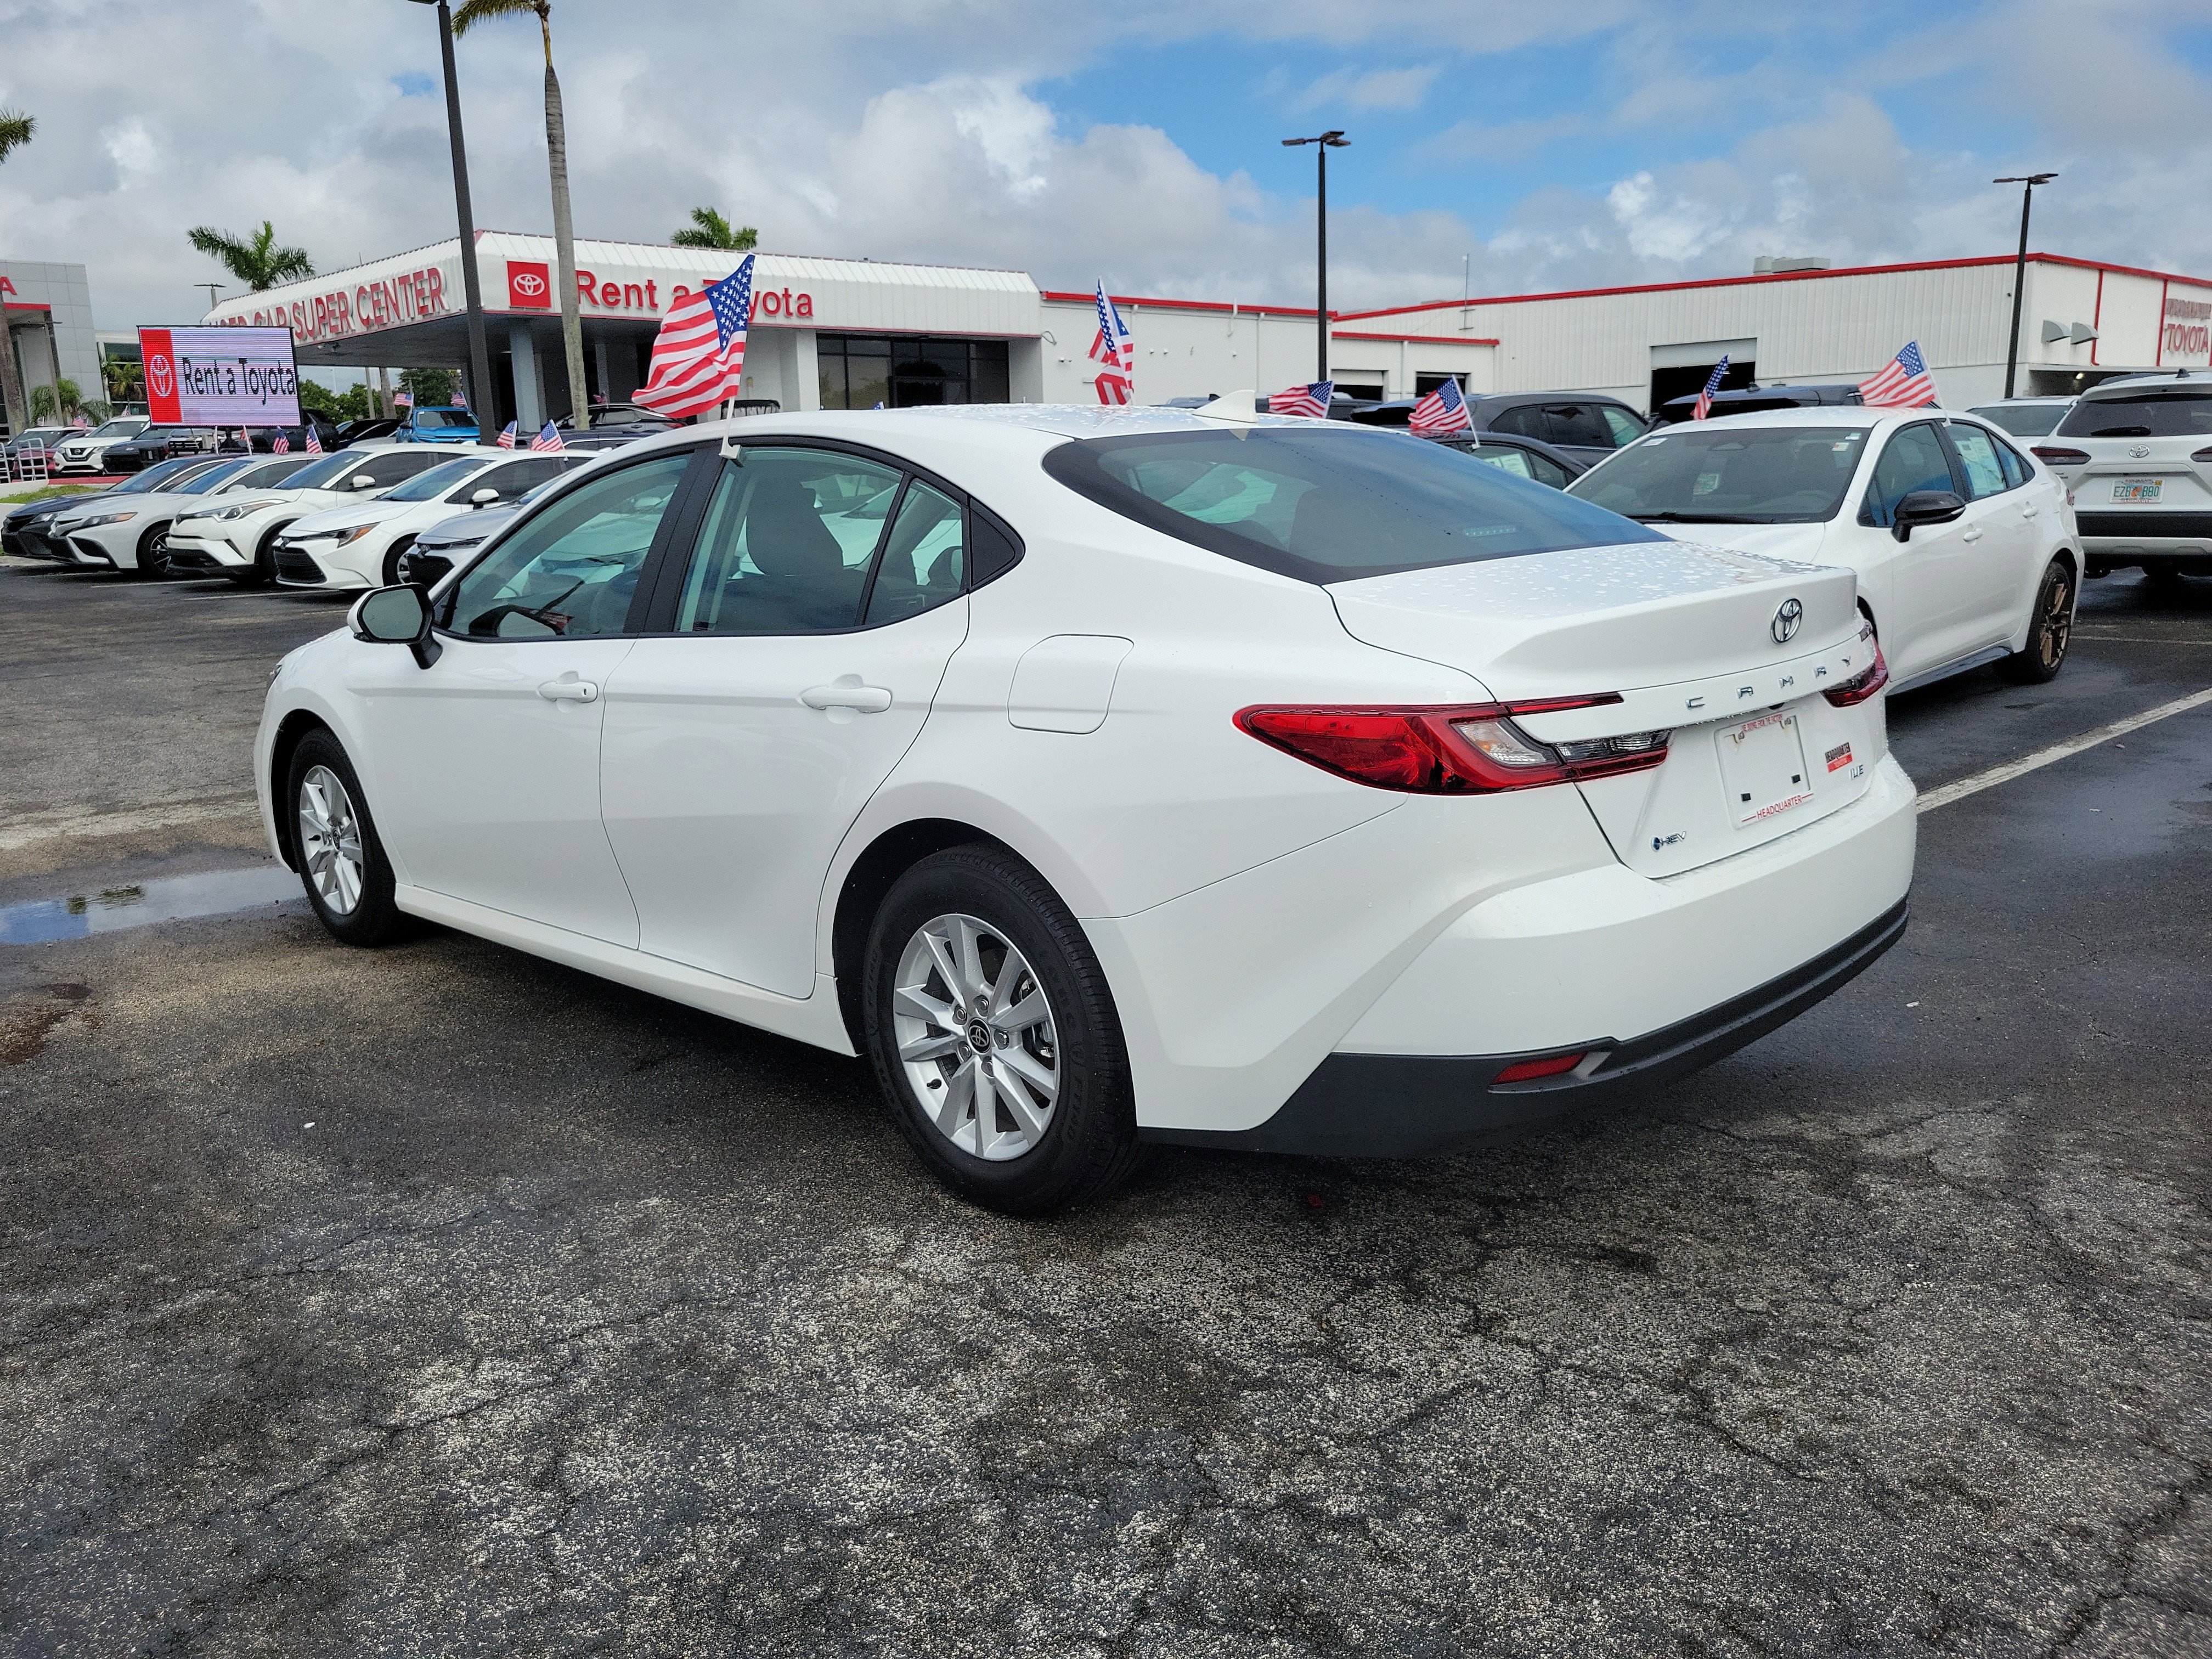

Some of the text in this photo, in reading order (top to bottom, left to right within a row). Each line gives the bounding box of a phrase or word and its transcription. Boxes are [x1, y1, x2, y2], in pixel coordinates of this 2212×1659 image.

[292, 267, 446, 340] SUPER CENTER
[575, 270, 659, 309] Rent
[2166, 323, 2209, 354] TOYOTA
[182, 358, 297, 405] Rent a Toyota
[1685, 656, 1852, 710] CAMRY
[1757, 795, 1802, 819] HEADQUARTER
[1660, 831, 1686, 846] HEV
